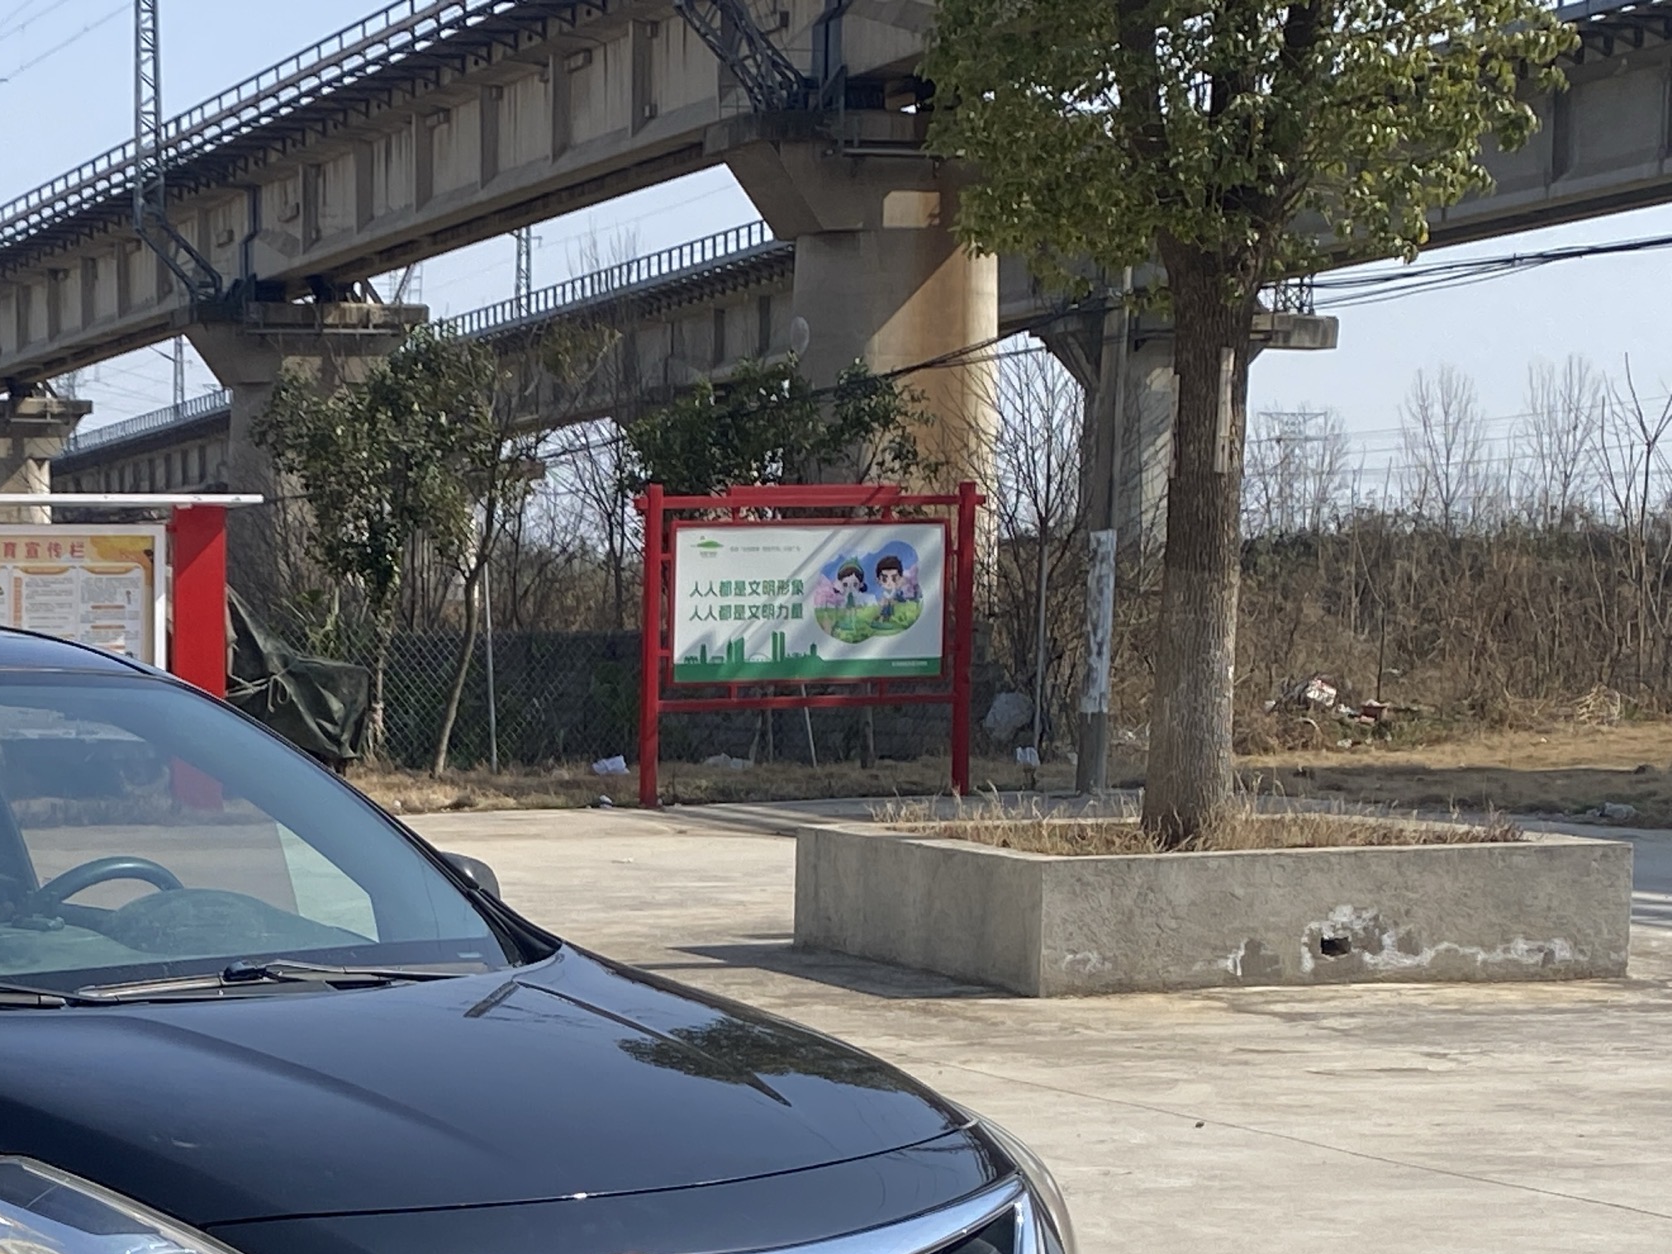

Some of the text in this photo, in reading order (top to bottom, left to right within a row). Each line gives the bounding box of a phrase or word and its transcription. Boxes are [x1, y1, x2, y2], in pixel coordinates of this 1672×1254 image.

[689, 579, 804, 597] 人人都是文明形象
[689, 602, 803, 621] 人人都是文明力量
